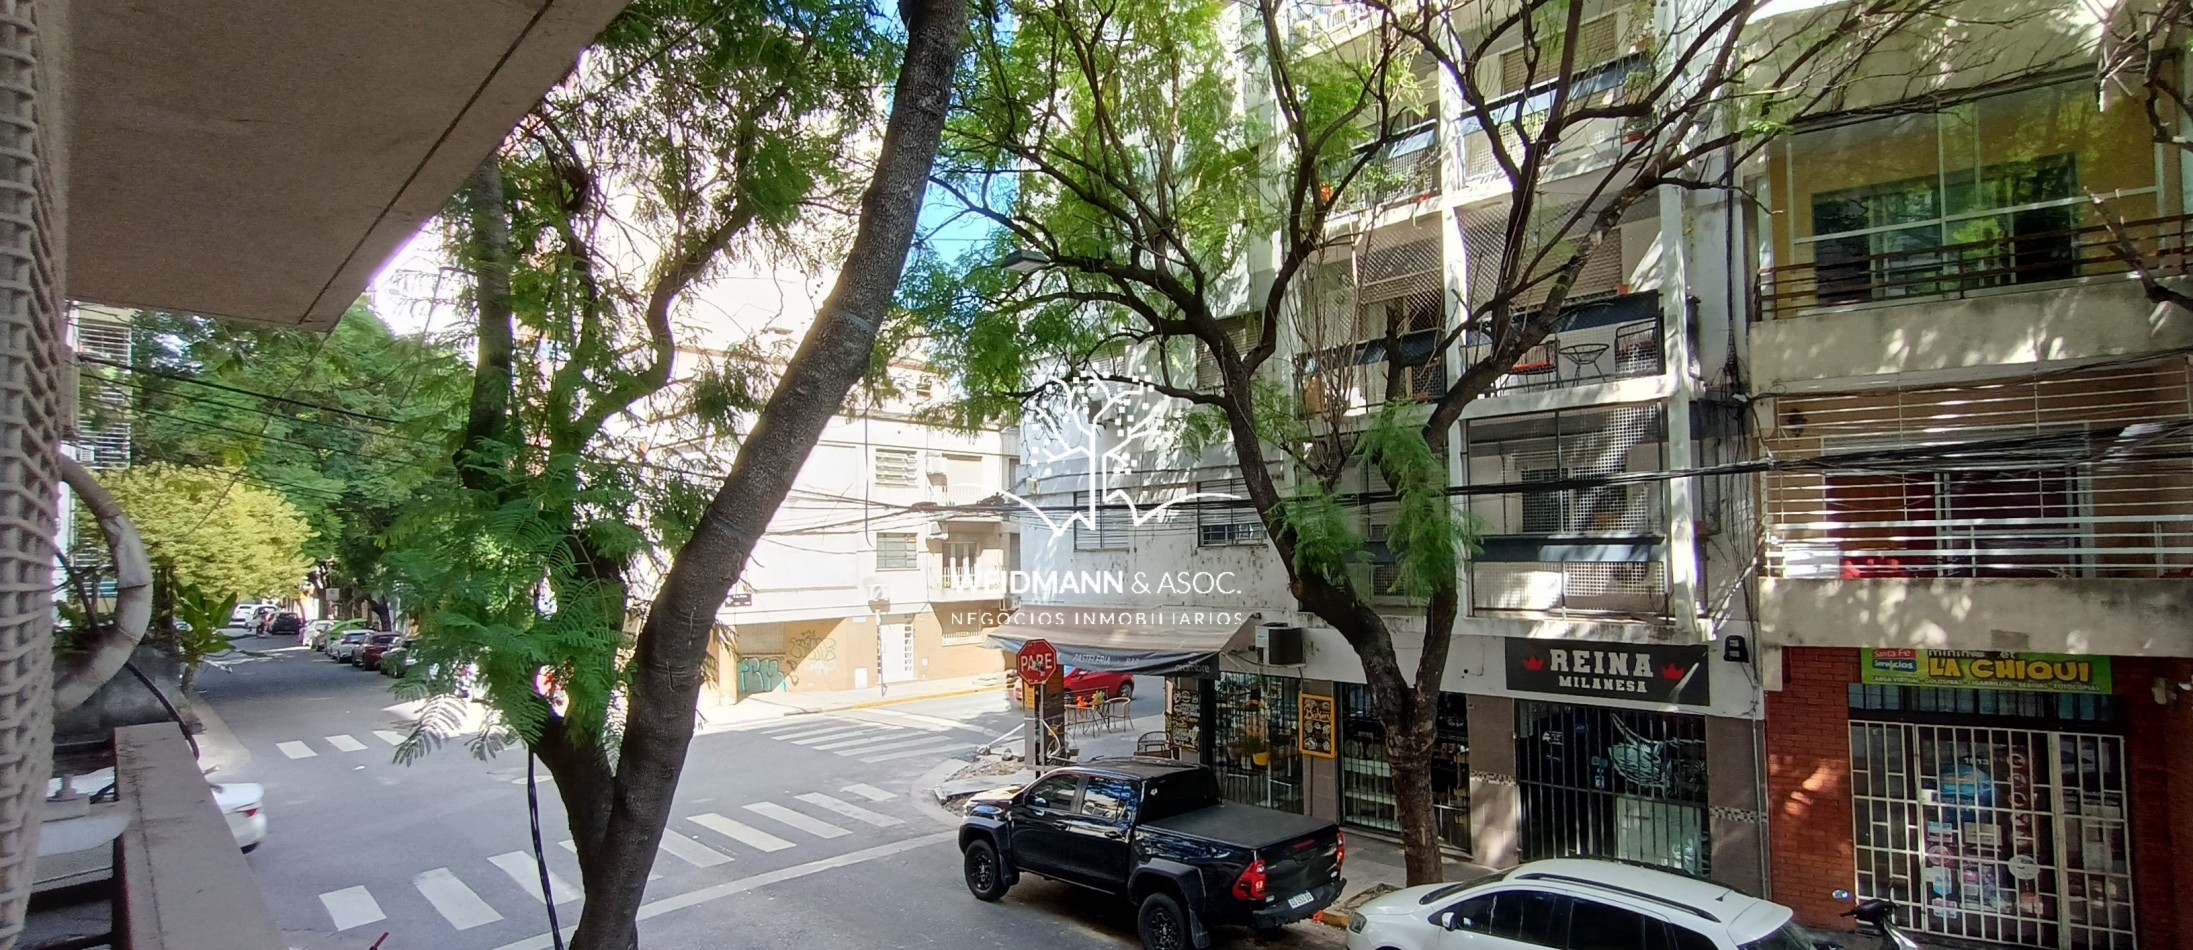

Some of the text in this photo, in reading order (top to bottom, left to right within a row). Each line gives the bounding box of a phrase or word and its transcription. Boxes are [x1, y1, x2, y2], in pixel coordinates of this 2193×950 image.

[1072, 653, 1111, 666] PASTELERIA
[1898, 649, 1911, 657] Fe
[1020, 653, 1053, 672] PARE
[1874, 659, 1914, 670] Servicios
[1929, 657, 2089, 682] LA CHIQUI
[1550, 649, 1654, 693] REINA MILANESA
